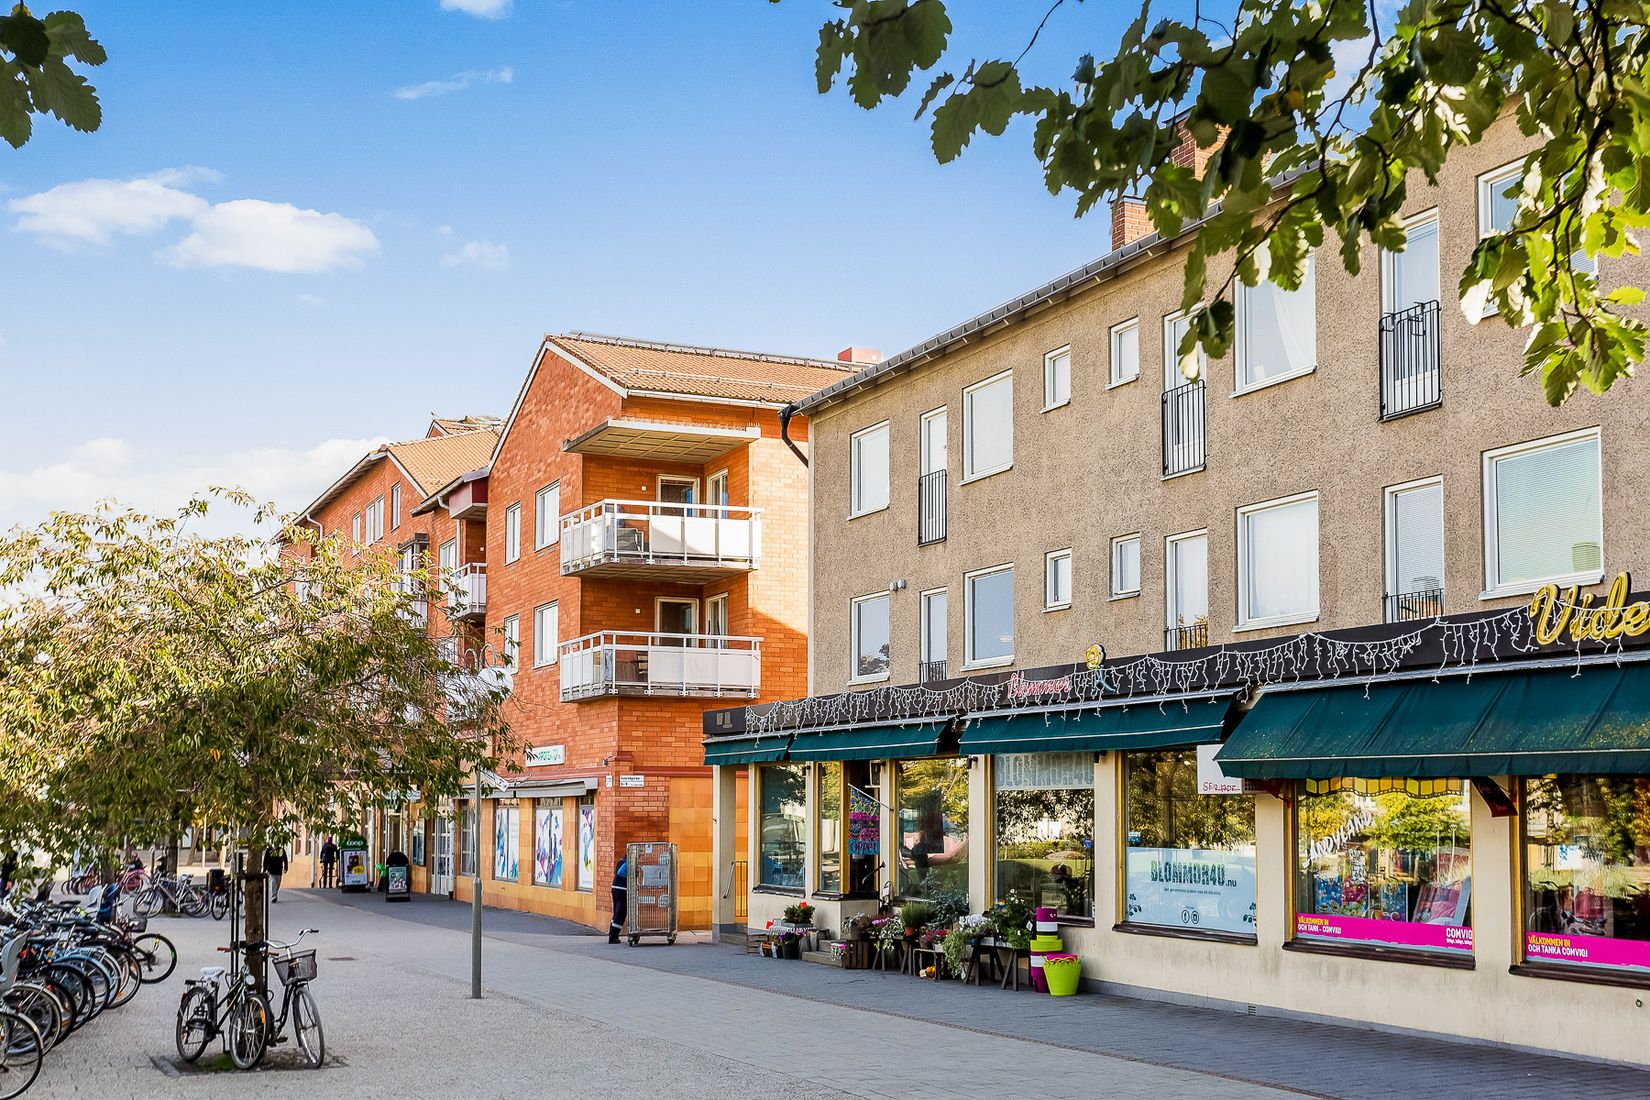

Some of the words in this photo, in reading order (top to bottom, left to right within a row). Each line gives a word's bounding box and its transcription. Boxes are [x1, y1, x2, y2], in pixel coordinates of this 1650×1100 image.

[1528, 935, 1563, 946] VÄLKOMMEN
[1528, 944, 1540, 952] OCH
[1541, 945, 1561, 954] TANKA
